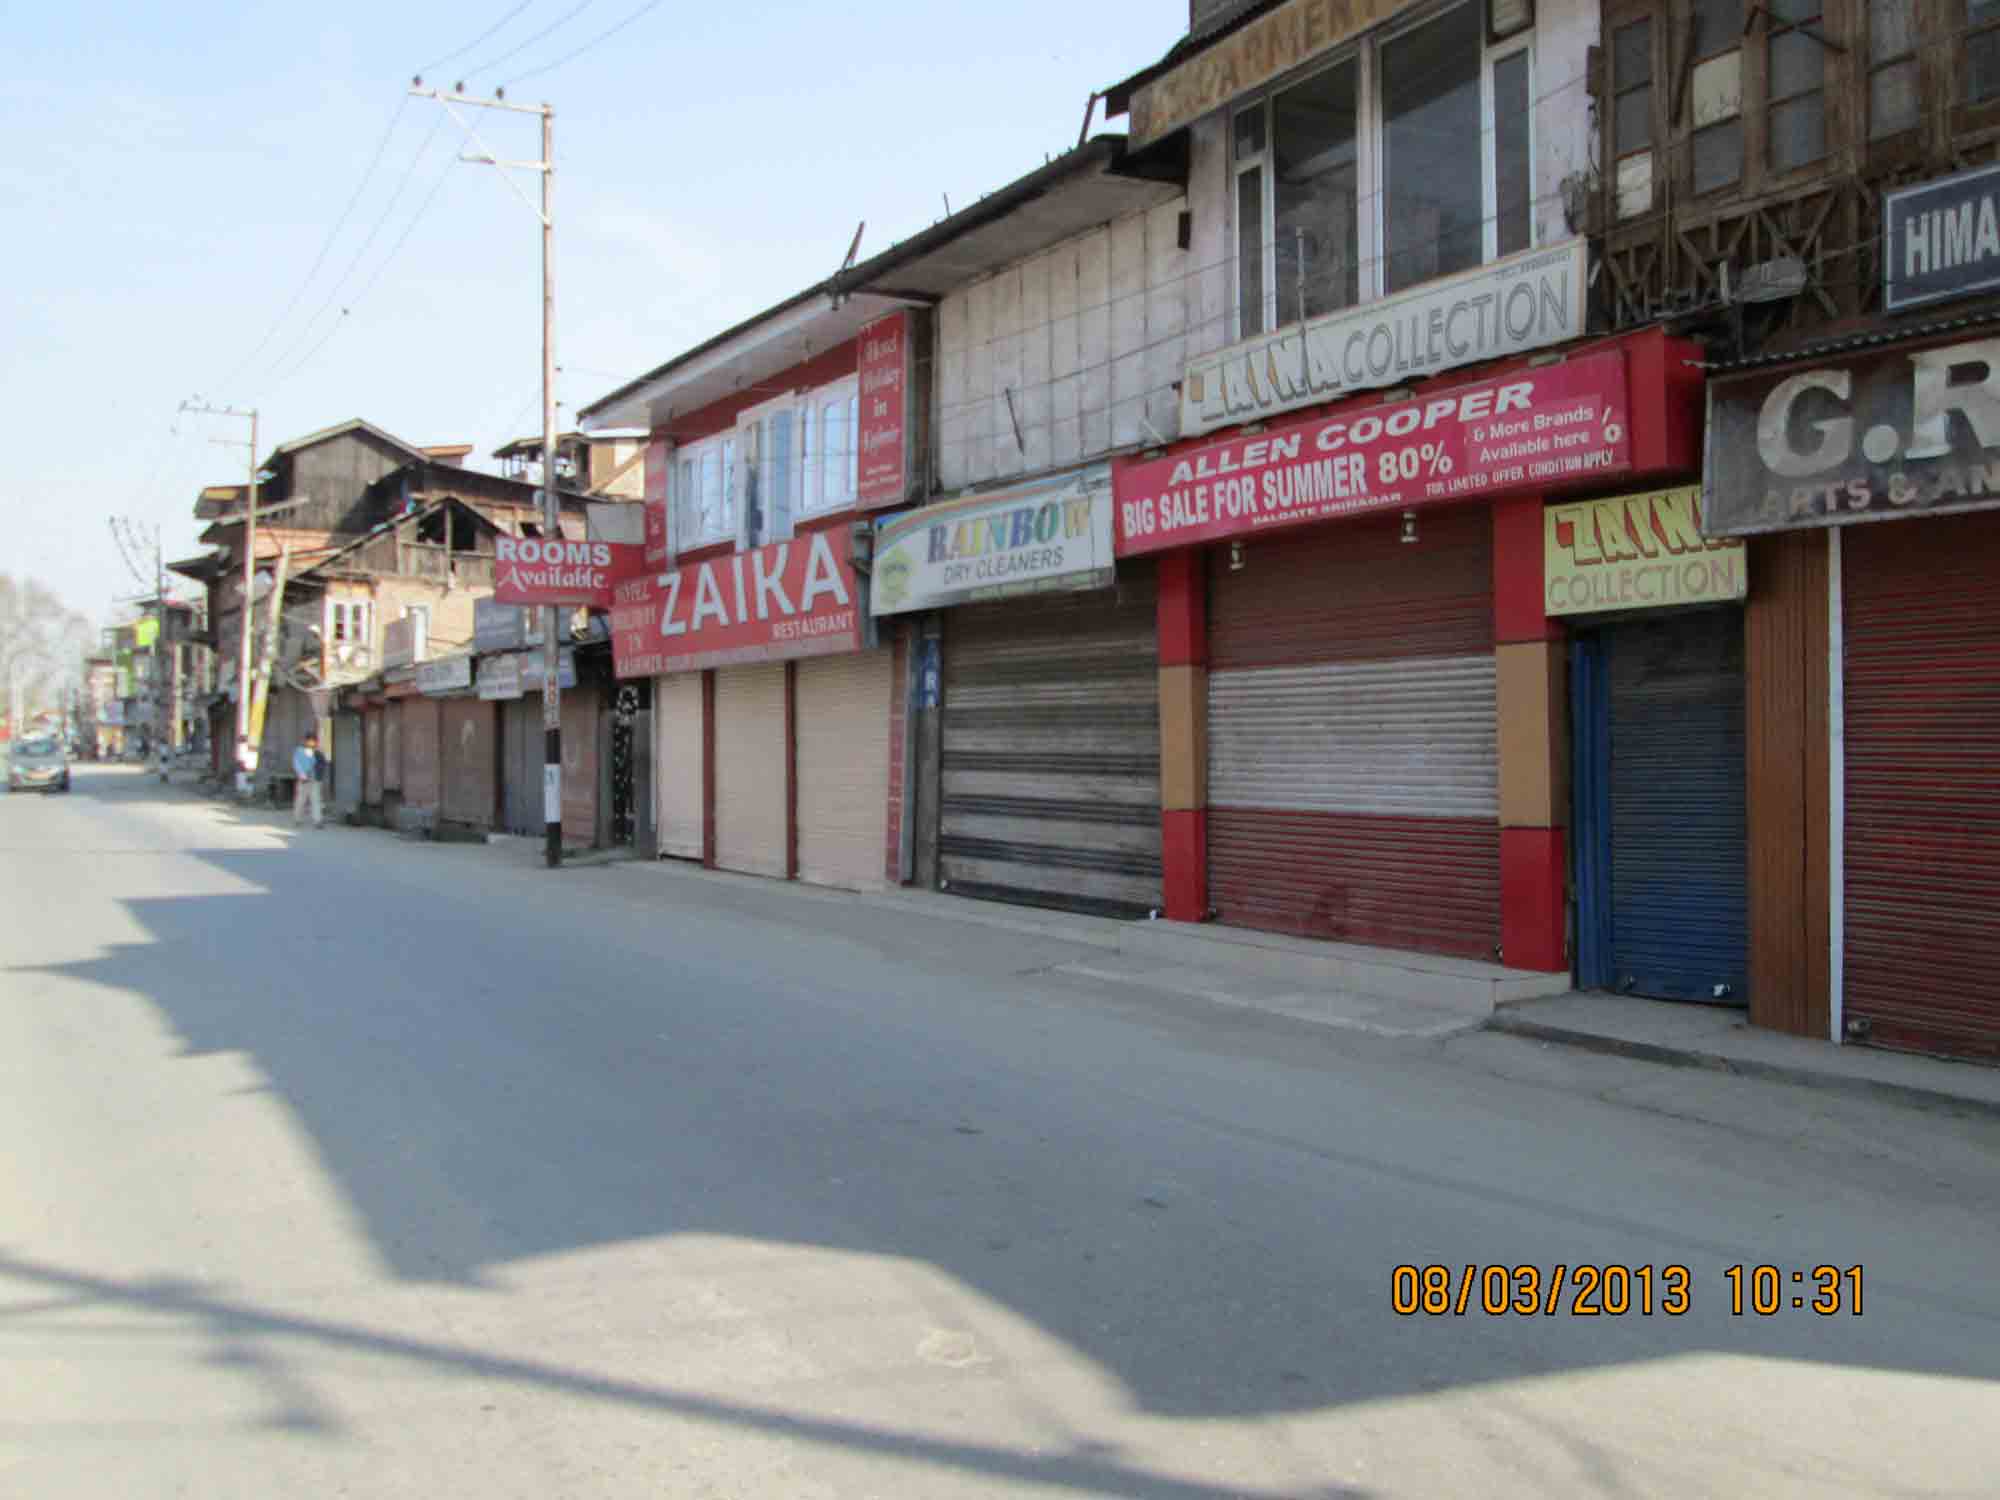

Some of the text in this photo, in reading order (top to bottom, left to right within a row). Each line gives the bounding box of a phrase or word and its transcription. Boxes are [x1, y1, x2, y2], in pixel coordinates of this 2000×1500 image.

[1343, 271, 1568, 384] COLLECTION
[1168, 382, 1535, 486] ALLEN COOPER
[1490, 421, 1529, 439] More
[1534, 406, 1594, 430] Brands
[1480, 430, 1590, 463] Available here
[1122, 440, 1453, 538] BIG SALE FOR SUMMER 80%
[1448, 474, 1488, 493] LIMITED
[1528, 457, 1582, 480] CONDITION
[1583, 448, 1614, 470] APPLY
[1888, 471, 1920, 505] &
[928, 496, 1090, 564] RAINBOW
[496, 538, 612, 567] ROOMS
[943, 564, 971, 585] DRY
[975, 545, 1065, 580] CLEANERS
[497, 564, 609, 592] Available
[657, 531, 850, 637] ZAIKA
[1549, 557, 1735, 608] COLLECTION
[771, 610, 856, 640] RESTAURANT
